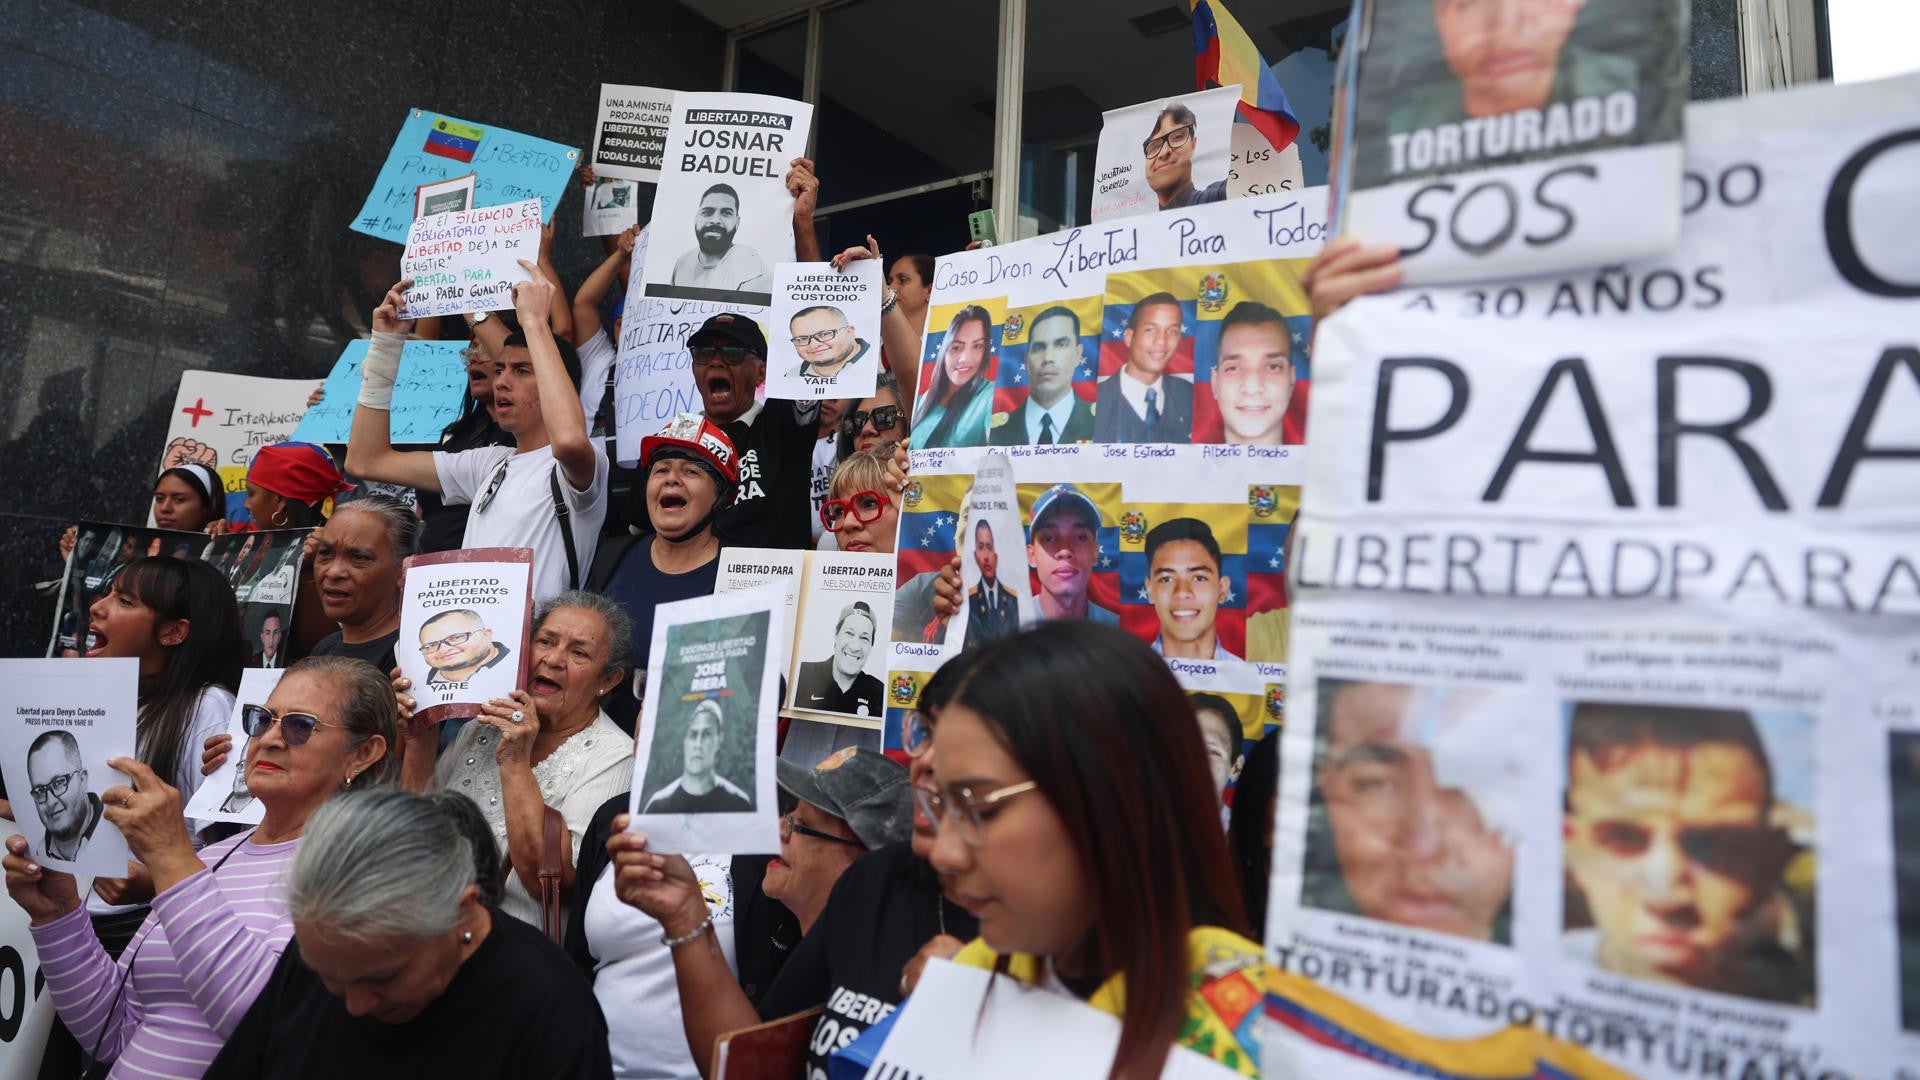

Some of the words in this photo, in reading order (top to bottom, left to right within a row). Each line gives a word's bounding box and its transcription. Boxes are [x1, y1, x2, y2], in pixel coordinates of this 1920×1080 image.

[606, 98, 624, 107] UNA
[626, 99, 672, 112] AMNISTÍA
[688, 111, 749, 125] LIBERTAD
[751, 114, 787, 127] PARA
[604, 124, 648, 137] LIBERTAD,
[1388, 91, 1637, 173] TORTURADO
[605, 138, 663, 151] REPARACIÓN
[684, 129, 784, 153] JOSNAR
[599, 151, 628, 162] TODAS
[629, 154, 648, 163] LAS
[1247, 149, 1270, 164] LOS
[680, 154, 779, 178] BADUEL
[456, 207, 513, 225] SILENCIO
[521, 202, 539, 217] ES
[1401, 165, 1598, 257] SOS
[494, 217, 541, 234] NUESTRA
[468, 240, 498, 254] DEJA
[505, 239, 521, 249] DE
[935, 262, 978, 291] Caso
[982, 254, 1032, 286] Dron
[1168, 217, 1226, 258] Para
[464, 269, 493, 281] PARA
[796, 275, 859, 283] LIBERTAD
[403, 292, 429, 305] JUAN
[436, 286, 464, 300] PABLO
[470, 281, 513, 298] GUANIPA
[786, 284, 822, 293] PARA
[824, 284, 867, 293] DENYS
[1545, 264, 1725, 318] AÑOS
[791, 293, 861, 302] CUSTODIO.
[436, 301, 463, 314] SEAN
[804, 376, 838, 385] YARE
[1368, 347, 1920, 512] PARA
[1034, 446, 1079, 456] Zambrano
[1103, 446, 1128, 458] Jose
[1247, 445, 1289, 459] Bracho
[740, 464, 762, 483] DE
[727, 564, 770, 575] LIBERTAD
[771, 565, 794, 575] PARA
[822, 566, 866, 576] LIBERTAD
[867, 568, 893, 577] PARA
[428, 578, 500, 588] LIBERTAD
[823, 579, 856, 590] NELSON
[858, 580, 892, 591] PIÑERO
[418, 588, 456, 600] PARA
[459, 587, 509, 596] DENYS
[422, 597, 501, 608] CUSTODIO.
[895, 642, 940, 656] Oswaldo
[694, 658, 726, 678] JOSÉ
[1171, 663, 1216, 677] Oropeza
[430, 682, 469, 691] YARE
[690, 674, 727, 692] RIERA
[16, 707, 40, 716] Libertad
[41, 709, 55, 718] para
[56, 707, 76, 717] Denys
[77, 707, 106, 717] Custodio
[25, 718, 41, 726] PRESO
[41, 716, 64, 727] POLÍTICO
[65, 718, 73, 726] EN
[74, 718, 87, 726] YARE
